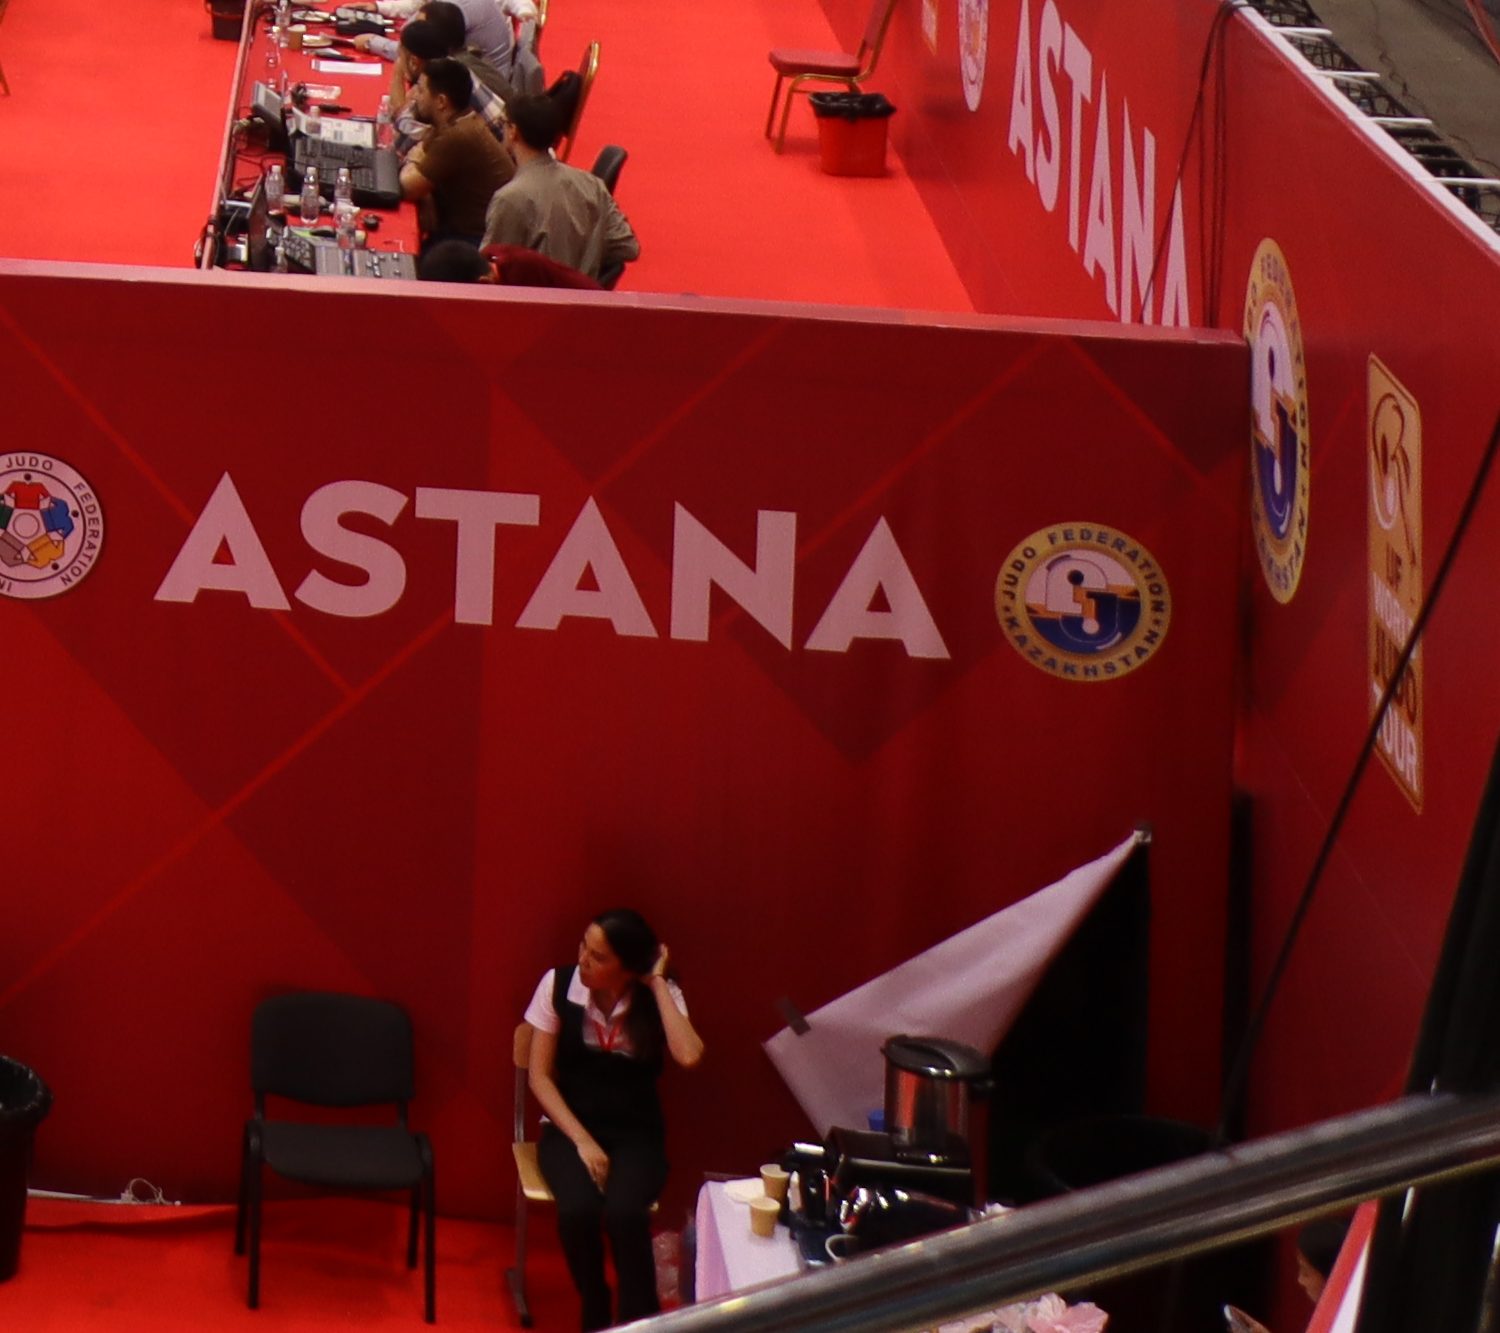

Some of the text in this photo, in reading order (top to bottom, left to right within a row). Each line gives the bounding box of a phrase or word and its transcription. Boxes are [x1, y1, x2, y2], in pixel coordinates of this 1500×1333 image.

[6, 455, 53, 471] JUDO
[153, 470, 952, 660] ASTANA
[1003, 546, 1036, 600] JUDO
